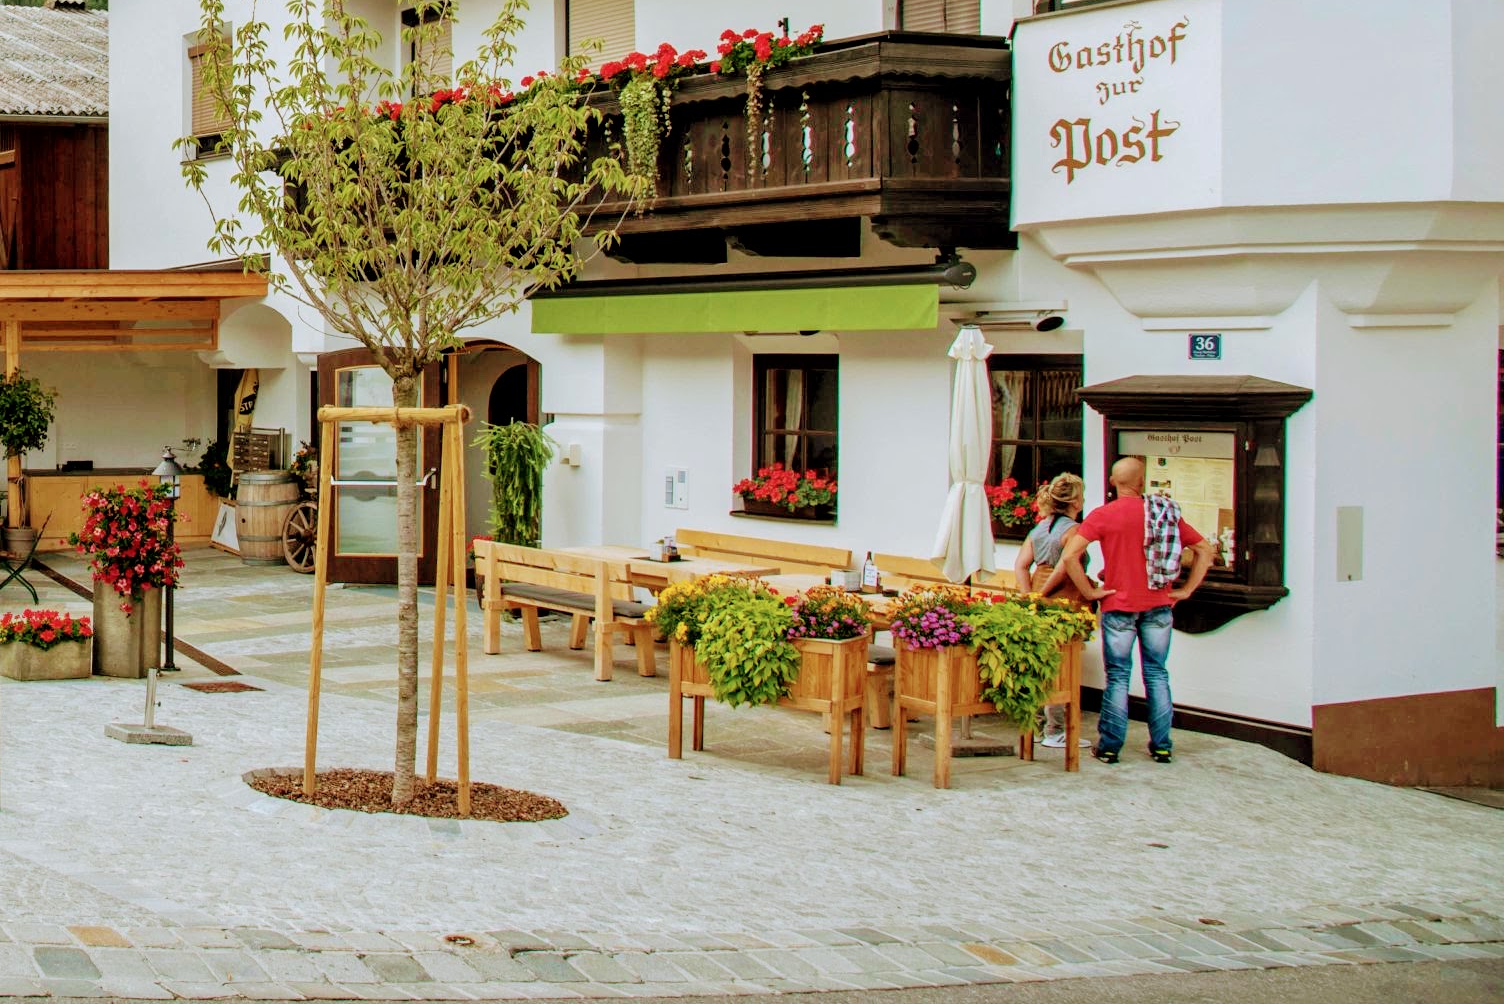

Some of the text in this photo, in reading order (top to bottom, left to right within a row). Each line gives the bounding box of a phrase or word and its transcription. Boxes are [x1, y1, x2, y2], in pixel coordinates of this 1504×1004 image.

[1048, 15, 1190, 74] Gasthof
[1096, 76, 1144, 106] zur
[1049, 109, 1181, 185] Post
[1195, 337, 1214, 350] 36
[1147, 434, 1202, 443] Gasthof Post
